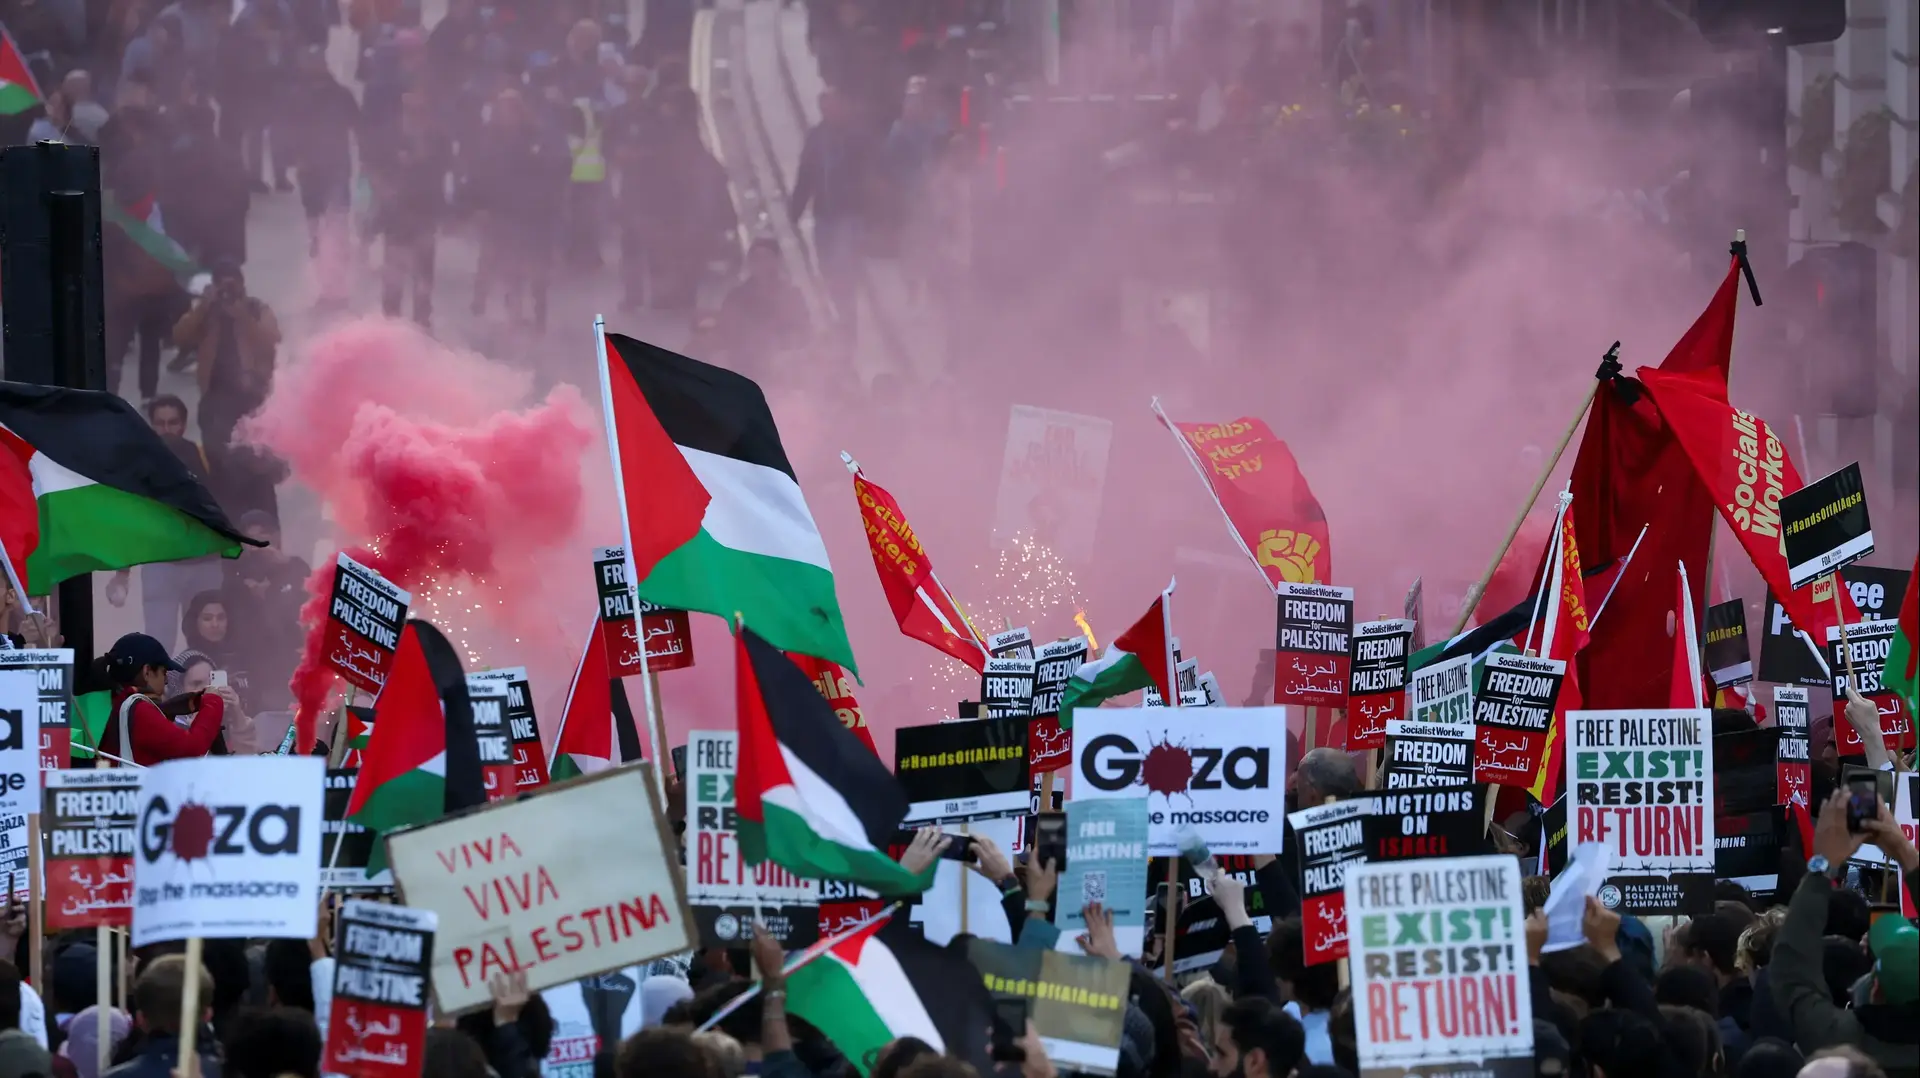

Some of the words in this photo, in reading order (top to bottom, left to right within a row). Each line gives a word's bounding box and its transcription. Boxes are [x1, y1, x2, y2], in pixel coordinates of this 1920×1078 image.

[1727, 408, 1757, 531] Socialis
[1752, 422, 1784, 539] Worker
[1786, 492, 1862, 536] #HandsOffAlAqsa
[863, 516, 917, 575] orkers
[340, 573, 398, 622] FREEDOM
[1289, 585, 1320, 596] Socialist
[1319, 588, 1343, 599] Worker
[1814, 581, 1831, 595] SWP
[1845, 580, 1884, 609] ee
[361, 606, 371, 617] for
[1285, 600, 1345, 622] FREEDOM
[333, 598, 397, 651] PALESTINE
[1311, 621, 1321, 631] for
[1362, 625, 1387, 635] Socialist
[340, 630, 381, 664] الحرية
[1043, 646, 1067, 658] Socialist
[1281, 629, 1348, 652] PALESTINE
[1357, 637, 1403, 660] FREEDOM
[1836, 639, 1893, 664] FREEDO
[1, 653, 29, 663] Socialist
[31, 654, 59, 662] Worker
[989, 662, 1016, 671] Socialist
[1037, 655, 1083, 684] FREEDOM
[1292, 657, 1336, 676] الحرية
[1378, 660, 1386, 669] for
[1498, 657, 1529, 669] Socialist
[1528, 662, 1555, 672] Worker
[1866, 661, 1876, 671] for
[986, 677, 1033, 698] FREEDOM
[1056, 681, 1065, 691] for
[1178, 665, 1197, 692] ESTINE
[1285, 677, 1342, 695] لفلسطين
[1352, 667, 1403, 691] PALESTINE
[1417, 674, 1436, 704] FREE
[1437, 663, 1468, 698] PALESTINE
[1487, 671, 1553, 698] FREEDOM
[1011, 698, 1019, 708] for
[1031, 692, 1064, 716] PALES
[1180, 696, 1197, 704] rker
[1360, 697, 1394, 718] الحرية
[1511, 695, 1523, 705] for
[1475, 702, 1549, 729] PALESTINE
[1779, 707, 1806, 726] FREEDOM
[1400, 725, 1436, 735] Socialist
[1436, 727, 1464, 738] Worker
[1481, 731, 1528, 753] الحرية
[1576, 719, 1615, 747] FREE
[1620, 718, 1702, 746] PALESTINE
[697, 740, 733, 769] FREE
[900, 746, 1023, 770] #HandsOffAlAqsa
[1394, 740, 1467, 765] FREEDOM
[1779, 738, 1809, 759] PALESTINE
[1080, 733, 1269, 791] Gza
[1424, 763, 1436, 774] for
[1576, 750, 1703, 779] EXIST!
[1372, 792, 1473, 815] ANCTIONS
[1577, 781, 1703, 805] RESIST!
[1171, 809, 1269, 824] massacre
[1402, 815, 1428, 836] ON
[142, 795, 302, 864] Gza
[1079, 820, 1116, 838] FREE
[1304, 819, 1363, 857] FREEDOM
[1578, 806, 1704, 857] RETURN!
[52, 829, 135, 854] PALESTIN
[436, 832, 522, 874] VIVA
[1066, 842, 1144, 862] ALESTINE
[1379, 835, 1448, 858] ISRAEL
[1715, 836, 1746, 848] RMING
[1305, 856, 1368, 894] PALES
[190, 881, 299, 898] massacre
[463, 865, 559, 921] VIVA
[1358, 874, 1404, 908] FREE
[1411, 867, 1510, 905] PALESTINE
[1625, 884, 1679, 892] PALESTINE
[1625, 892, 1685, 900] SOLIDARITY
[1625, 900, 1678, 908] CAMPAIGN
[1361, 907, 1512, 947] EXIST!
[345, 924, 423, 963] FREEDOM
[453, 893, 671, 988] PALESTINA
[1364, 945, 1514, 979] RESIST!
[336, 966, 424, 1005] PALESTINE
[1367, 975, 1519, 1043] RETURN!
